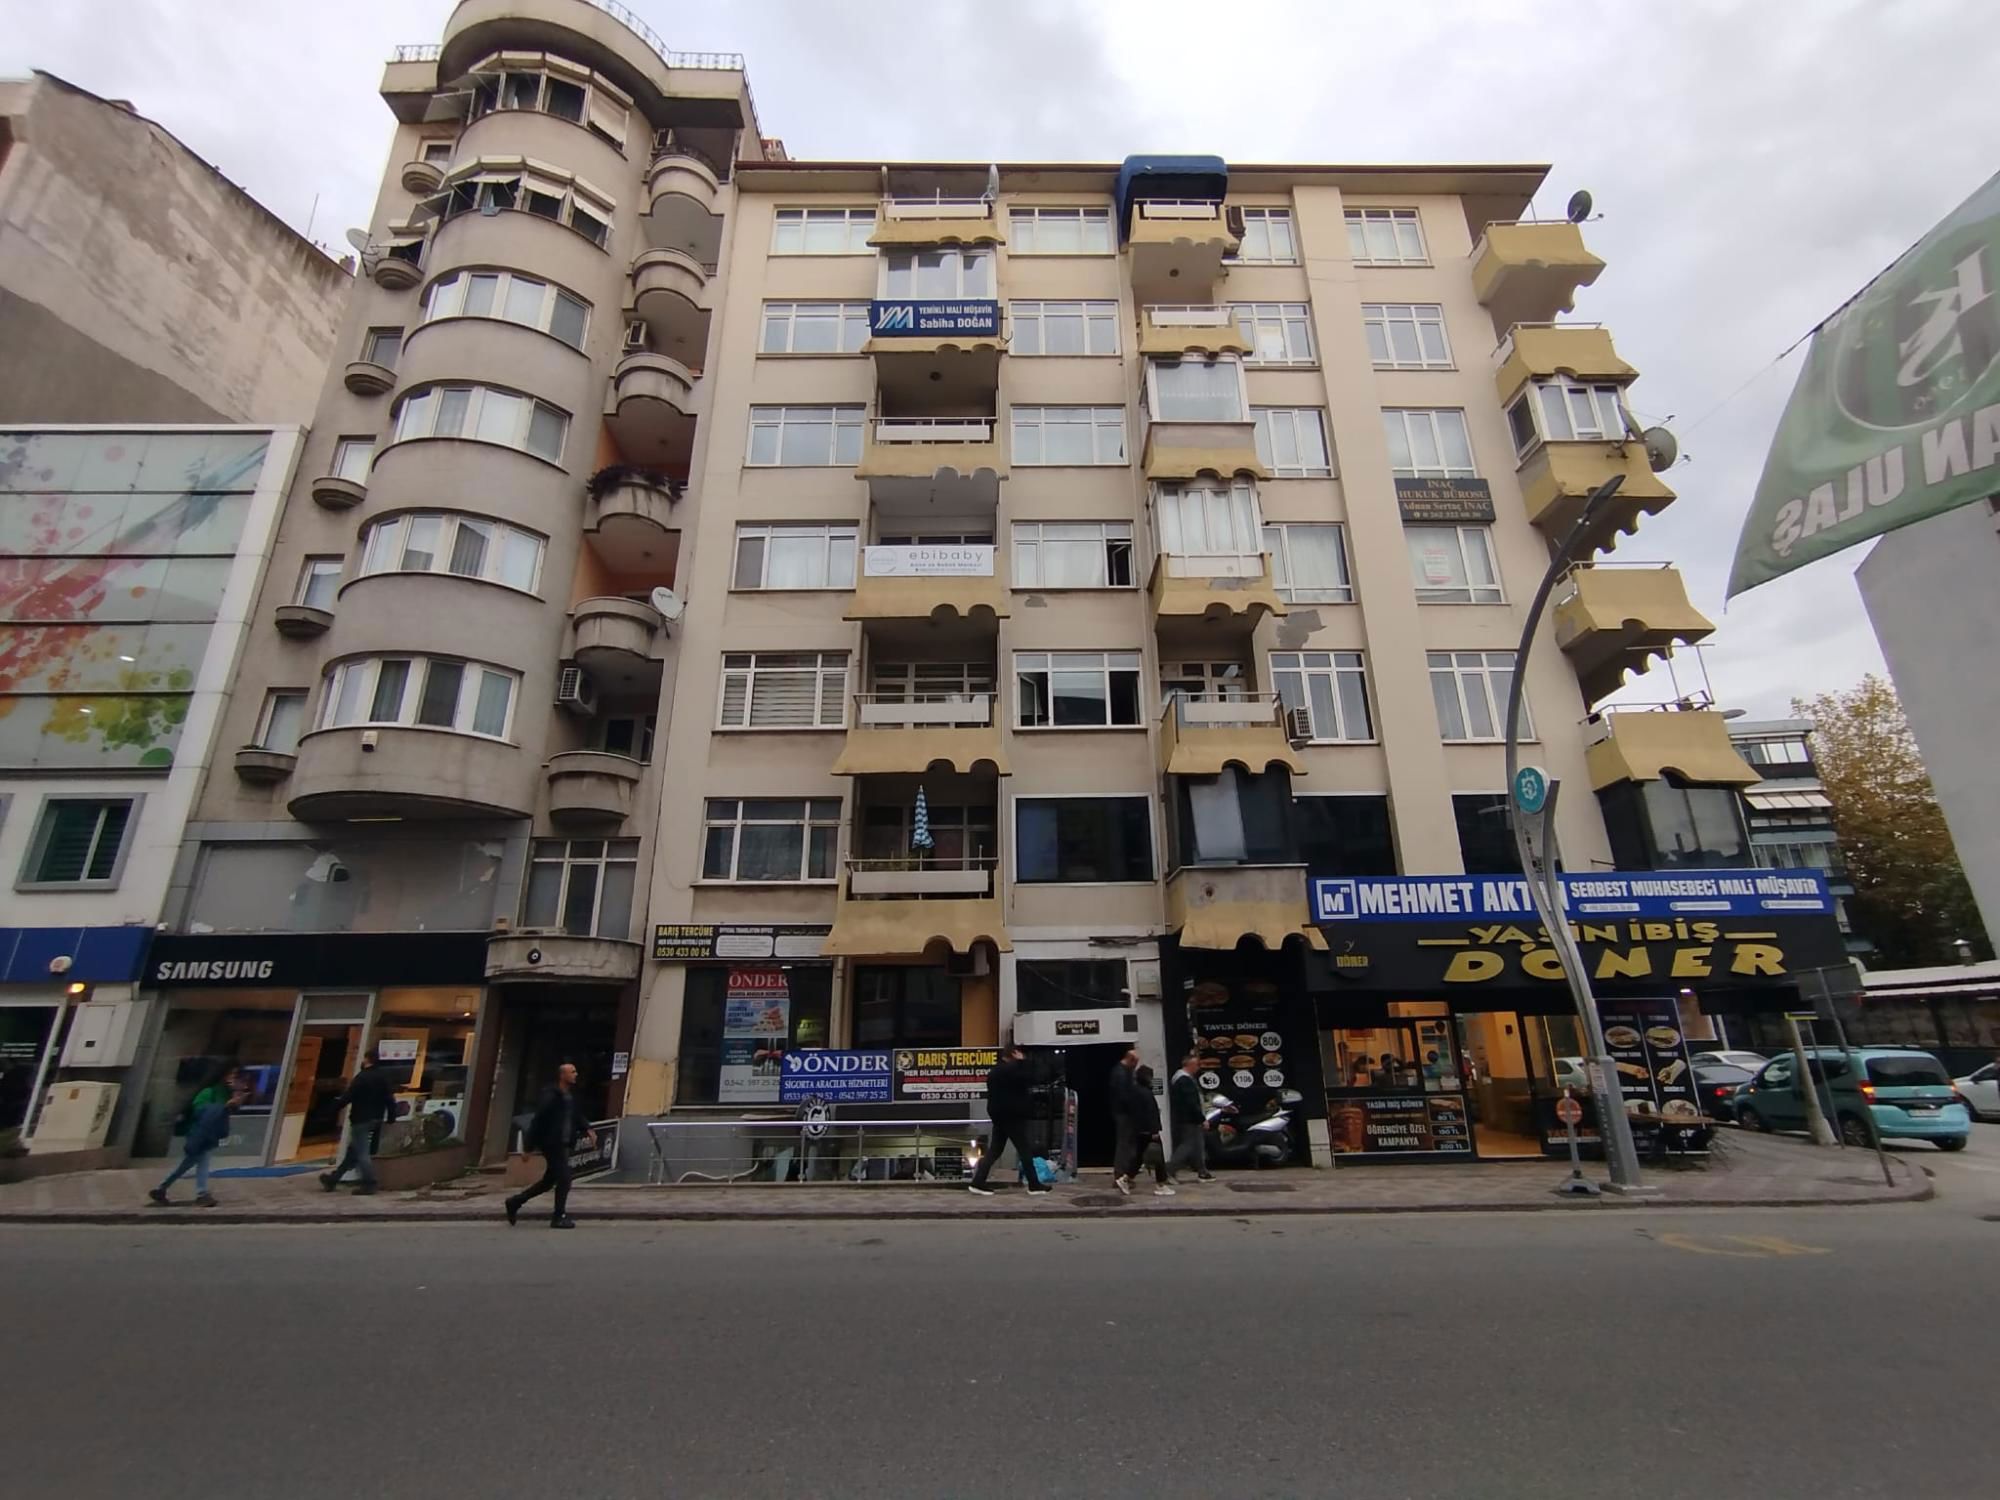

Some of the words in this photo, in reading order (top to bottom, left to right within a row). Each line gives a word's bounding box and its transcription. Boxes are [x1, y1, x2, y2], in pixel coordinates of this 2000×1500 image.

[919, 304, 945, 315] YEMİNLİ
[946, 304, 962, 315] MALİ
[963, 304, 993, 317] MÜŞAVİR
[919, 318, 955, 329] Sabiha
[957, 316, 993, 329] DOĞAN
[1399, 490, 1440, 499] HUKUK
[1443, 489, 1488, 499] BÜROSU
[1464, 500, 1491, 512] İNAÇ
[908, 550, 984, 562] ebibaby
[1359, 882, 1475, 914] MEHMET
[1570, 881, 1628, 898] SERBEST
[658, 926, 679, 939] BARIŞ
[681, 925, 714, 937] TERCÜME
[1629, 917, 1720, 944] İBİŞ
[656, 947, 675, 957] 0530
[675, 947, 689, 957] 433
[690, 947, 700, 957] 00
[1443, 942, 1787, 983] DÖNER
[157, 960, 274, 980] SAMSUNG
[728, 971, 789, 988] ÖNDER
[1204, 1023, 1234, 1031] TAVUK
[803, 1053, 890, 1073] ÖNDER
[917, 1053, 948, 1069] BARIŞ
[949, 1049, 998, 1067] TERCÜME
[904, 1069, 919, 1077] HER
[945, 1068, 974, 1077] NOTERLİ
[784, 1078, 814, 1089] SİGORTA
[815, 1078, 848, 1089] ARACILIK
[848, 1076, 888, 1088] HİZMETLERİ
[839, 1091, 855, 1100] 0542
[921, 1092, 940, 1100] 0530
[942, 1092, 957, 1100] 433
[958, 1092, 969, 1100] 00
[1409, 1122, 1427, 1134] ÖZEL
[1378, 1136, 1420, 1147] KAMPANYA
